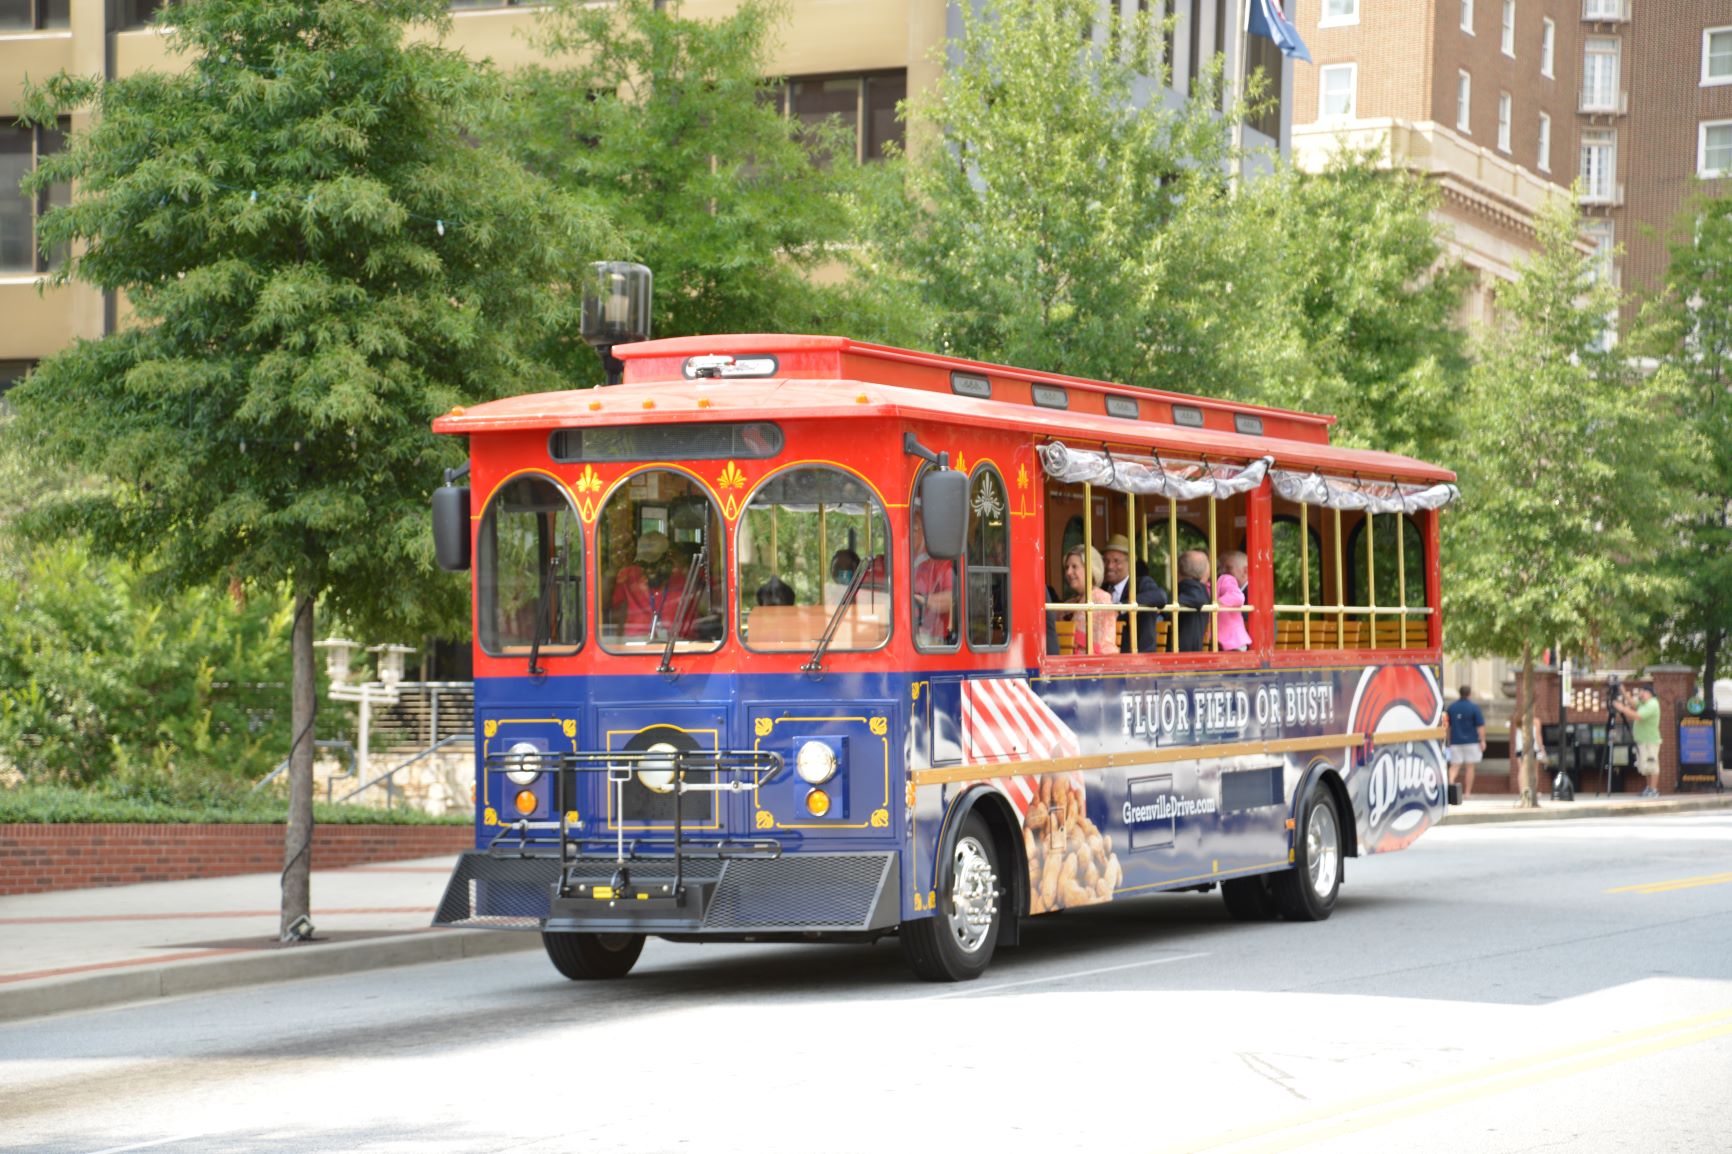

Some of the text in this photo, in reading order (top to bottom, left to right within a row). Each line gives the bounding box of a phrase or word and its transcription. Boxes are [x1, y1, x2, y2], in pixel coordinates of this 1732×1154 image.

[1121, 684, 1334, 735] FLUOR FIELD OR BUST!
[1123, 794, 1215, 824] GreenvilleDrive.com
[1369, 742, 1439, 828] Drive
